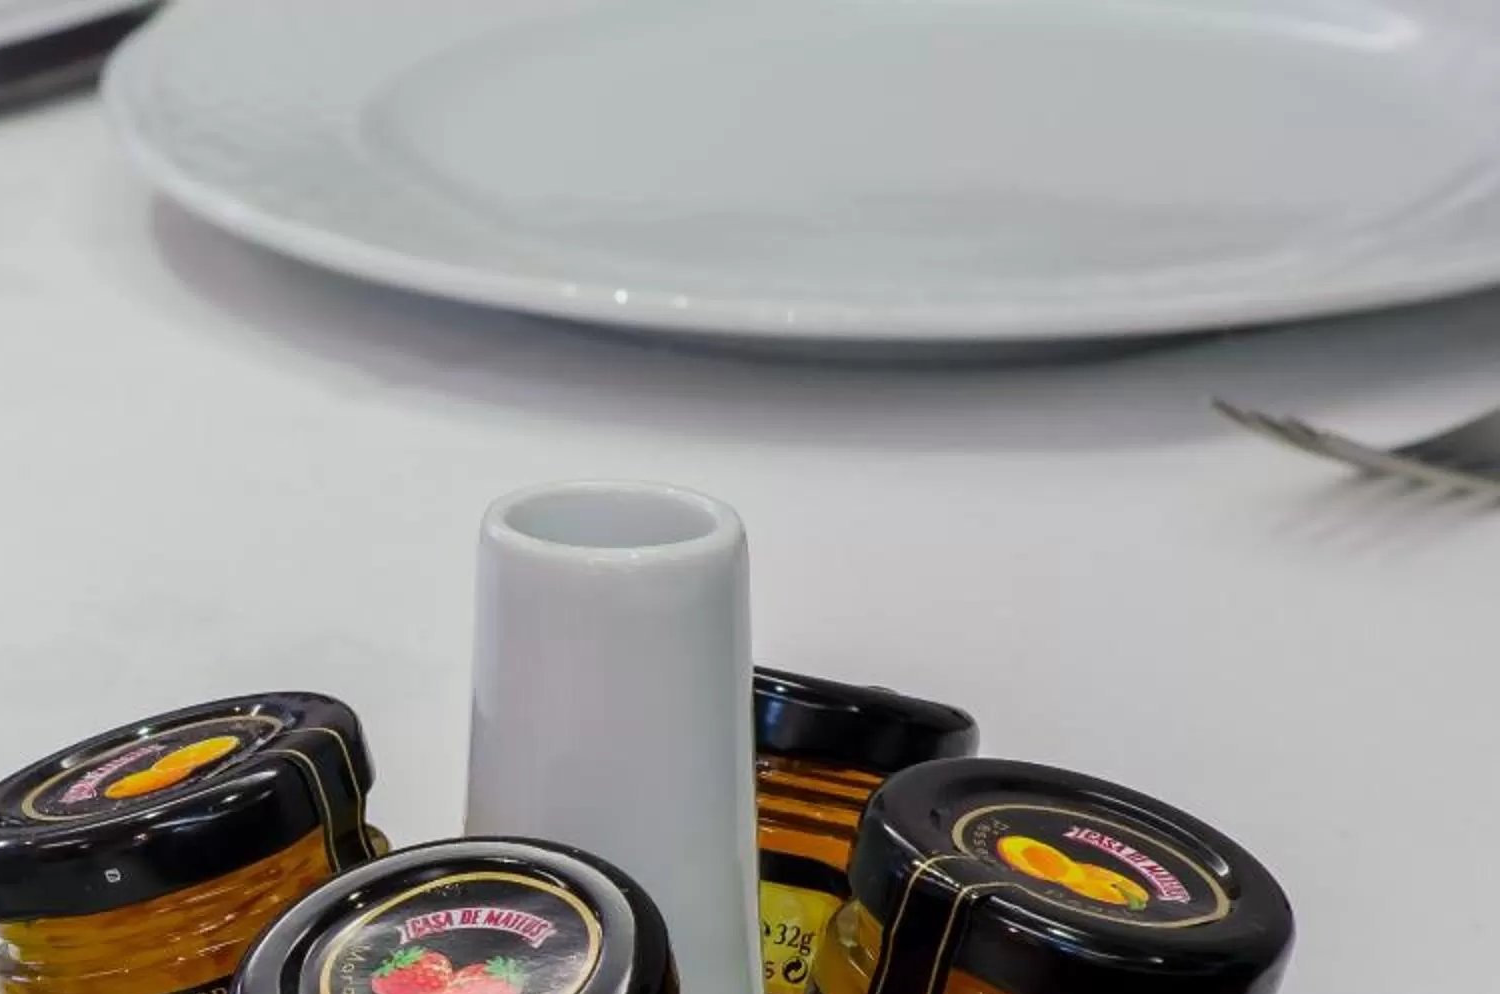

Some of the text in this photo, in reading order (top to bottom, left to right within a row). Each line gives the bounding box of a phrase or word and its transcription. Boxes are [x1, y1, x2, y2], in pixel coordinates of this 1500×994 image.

[411, 908, 551, 938] CASA DE MATEUS
[773, 922, 815, 956] 32g
